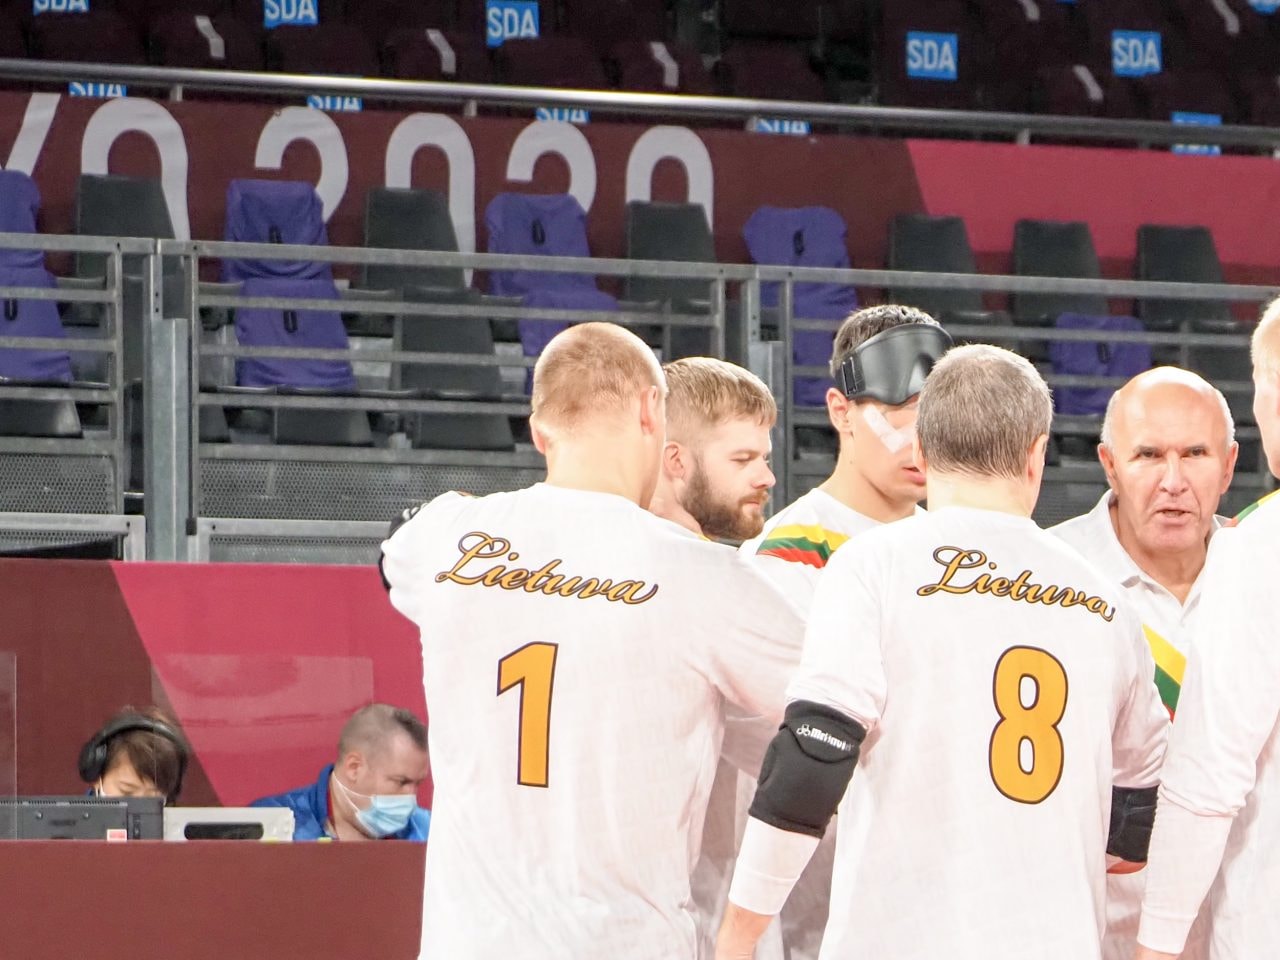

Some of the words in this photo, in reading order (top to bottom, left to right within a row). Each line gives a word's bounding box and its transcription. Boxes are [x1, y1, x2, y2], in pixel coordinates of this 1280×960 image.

[488, 7, 539, 38] SDA
[907, 38, 956, 72] SDA
[1112, 38, 1162, 69] SDA
[435, 531, 659, 605] Lietuva
[917, 545, 1116, 622] Lietuva
[497, 641, 559, 788] 1
[989, 645, 1069, 804] 8
